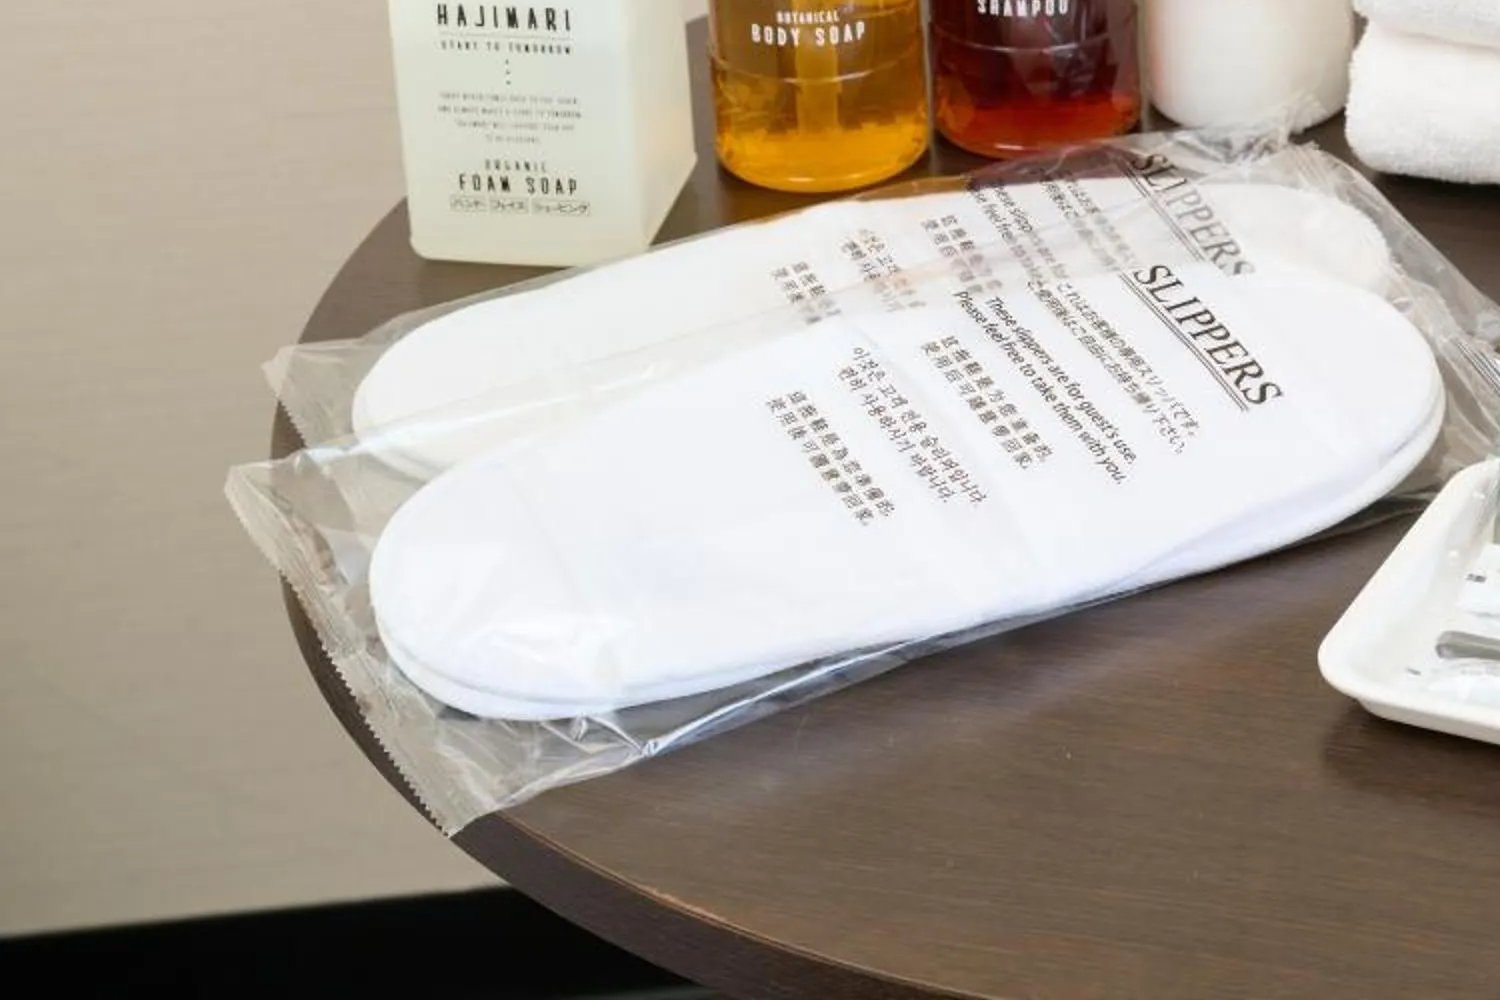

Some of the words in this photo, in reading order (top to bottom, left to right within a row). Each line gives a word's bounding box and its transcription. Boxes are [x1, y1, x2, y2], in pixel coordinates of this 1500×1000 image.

[437, 3, 571, 31] HAJIMARI
[751, 23, 800, 46] BODY
[816, 21, 866, 46] SOAP
[776, 10, 840, 24] BOTANICAL
[459, 174, 511, 192] FOAM
[526, 177, 577, 196] SOAP
[1131, 153, 1255, 275] SLIPPERS
[1133, 265, 1283, 405] SLIPPERS
[850, 346, 887, 383] 이것은
[954, 291, 991, 324] Please
[980, 321, 1010, 342] feel
[998, 341, 1026, 362] free
[1019, 362, 1038, 376] to
[1030, 375, 1061, 400] take
[1052, 401, 1088, 431] them
[1077, 429, 1110, 454] with
[1094, 454, 1130, 483] you.
[984, 296, 1019, 325] These
[1010, 327, 1054, 364] slippers
[1046, 365, 1070, 382] are
[1062, 383, 1086, 399] for
[1075, 402, 1121, 437] guest's
[1112, 439, 1137, 462] use.
[859, 392, 916, 451] 사용하시기
